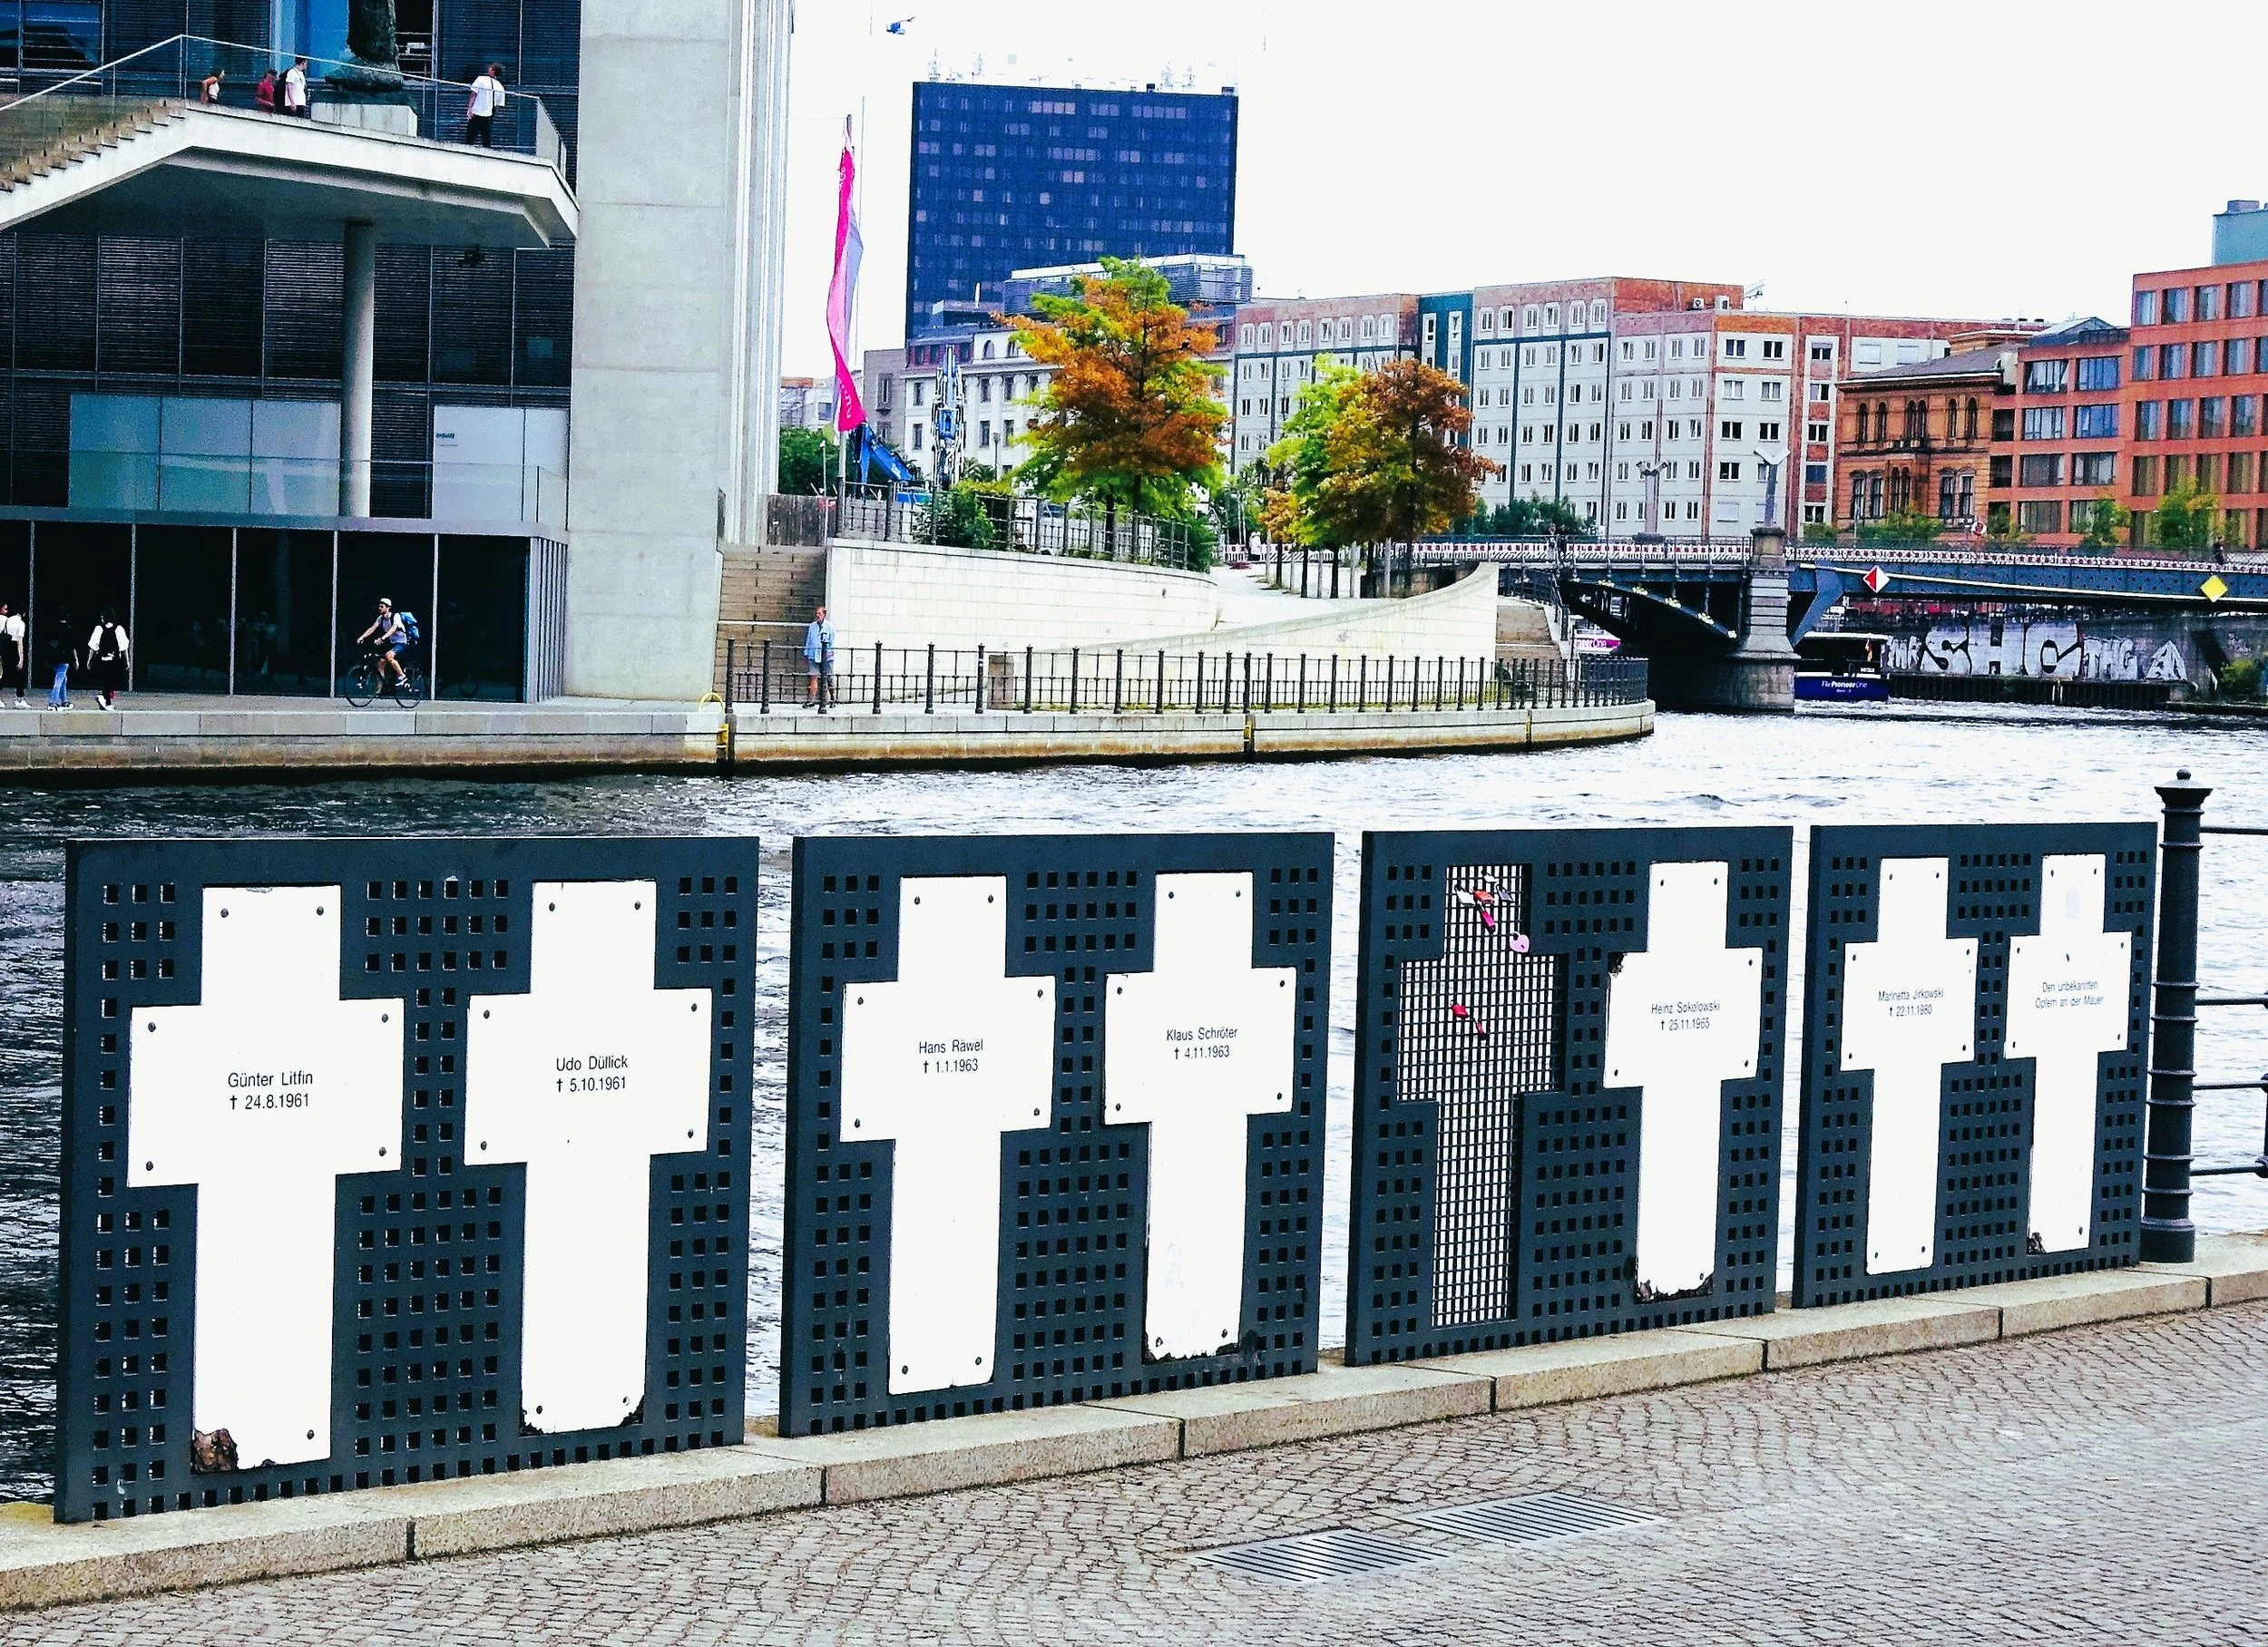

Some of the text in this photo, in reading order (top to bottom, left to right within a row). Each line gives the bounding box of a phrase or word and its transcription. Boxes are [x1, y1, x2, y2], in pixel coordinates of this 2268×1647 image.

[2042, 981, 2056, 993] Den
[1651, 1000, 1720, 1015] Heinz Sokolowski
[2059, 999, 2068, 1007] an
[2070, 998, 2081, 1007] der
[2083, 995, 2104, 1006] Mauer
[1896, 1003, 1933, 1017] 22.11.1980
[1668, 1017, 1711, 1031] 25.11.1965
[1166, 1027, 1238, 1041] Klaus Schröter
[919, 1038, 983, 1054] Hans Räwel
[1184, 1044, 1230, 1059] 4.11.1963
[556, 1055, 629, 1071] Udo Düllick
[935, 1057, 979, 1073] 1.1.1963
[228, 1070, 313, 1088] Günter Litfin
[570, 1076, 626, 1093] 5.10.1961
[245, 1092, 308, 1110] 24.8.1961
